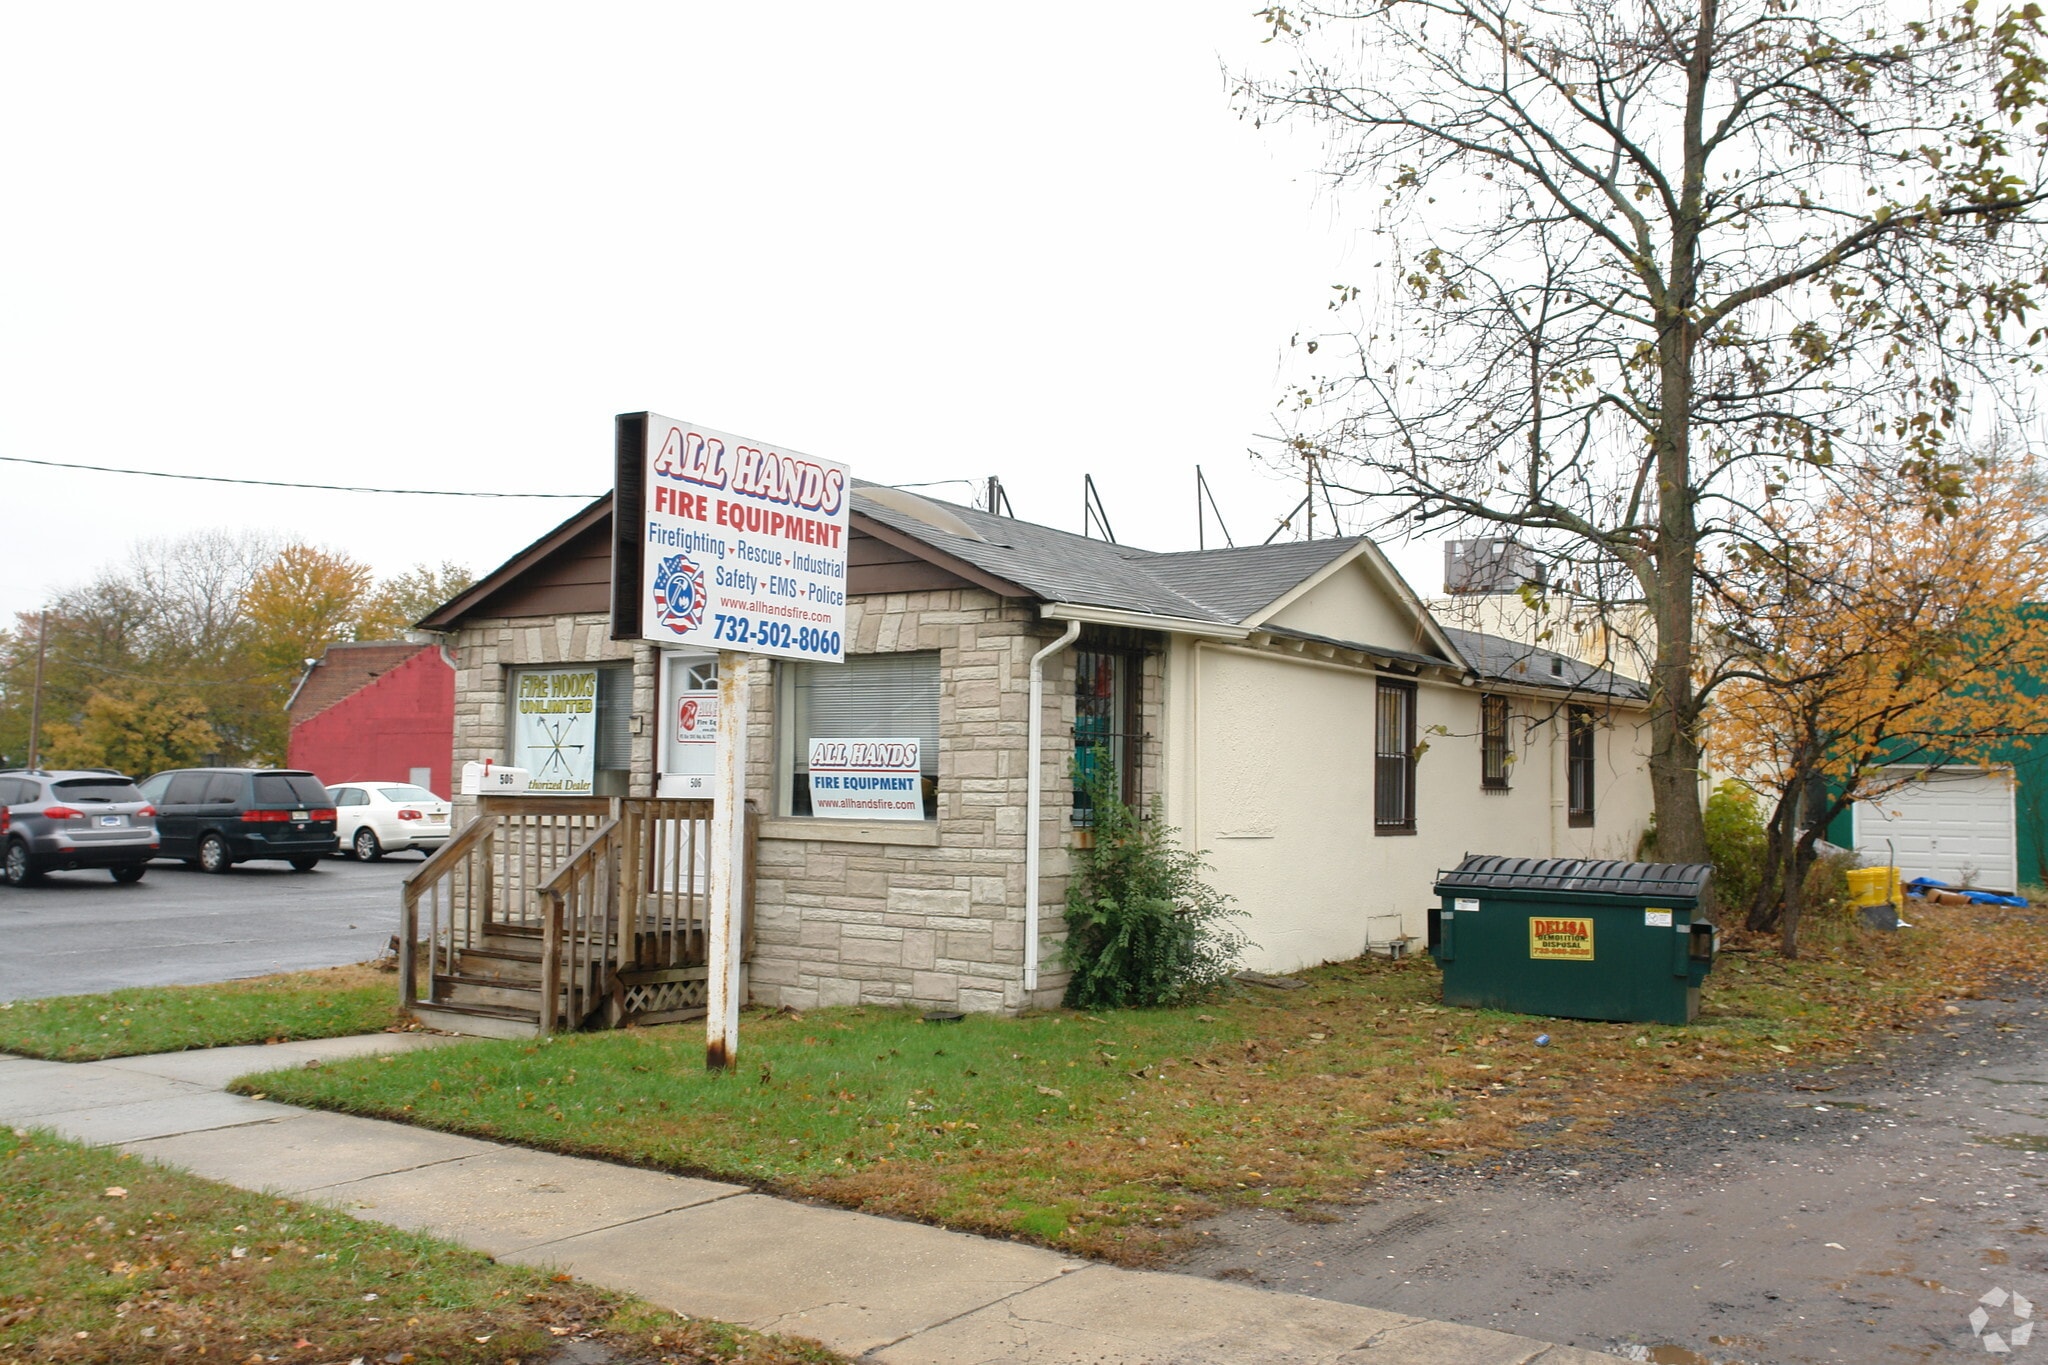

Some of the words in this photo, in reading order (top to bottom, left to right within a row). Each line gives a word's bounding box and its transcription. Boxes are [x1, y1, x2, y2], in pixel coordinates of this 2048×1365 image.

[654, 427, 727, 491] ALL
[731, 446, 844, 517] HANDS
[655, 485, 708, 522] FIRE
[716, 499, 842, 549] EQUIPMENT
[649, 522, 725, 560] Firefighting
[738, 540, 782, 566] Rescue
[793, 551, 844, 579] Industrial
[716, 565, 757, 595] Safety
[770, 575, 797, 598] EMS
[809, 583, 843, 607] Police
[720, 596, 832, 624] www.allhandsfire.com
[713, 613, 840, 655] 732-502-8060
[519, 674, 549, 698] FIRE
[551, 673, 596, 698] HOOKS
[519, 699, 593, 714] UNLIMITED
[709, 719, 717, 727] Eq
[811, 743, 848, 767] ALL
[850, 743, 918, 768] HANDS
[499, 774, 514, 785] 506
[528, 779, 562, 790] thorized
[565, 779, 591, 790] Dealer
[690, 777, 702, 788] 506
[815, 776, 840, 789] FIRE
[843, 776, 914, 791] EQUIPMENT
[817, 798, 916, 810] www.allhandsfire.com
[1535, 920, 1588, 938] DELISA
[1538, 934, 1586, 942] DEMOLITION
